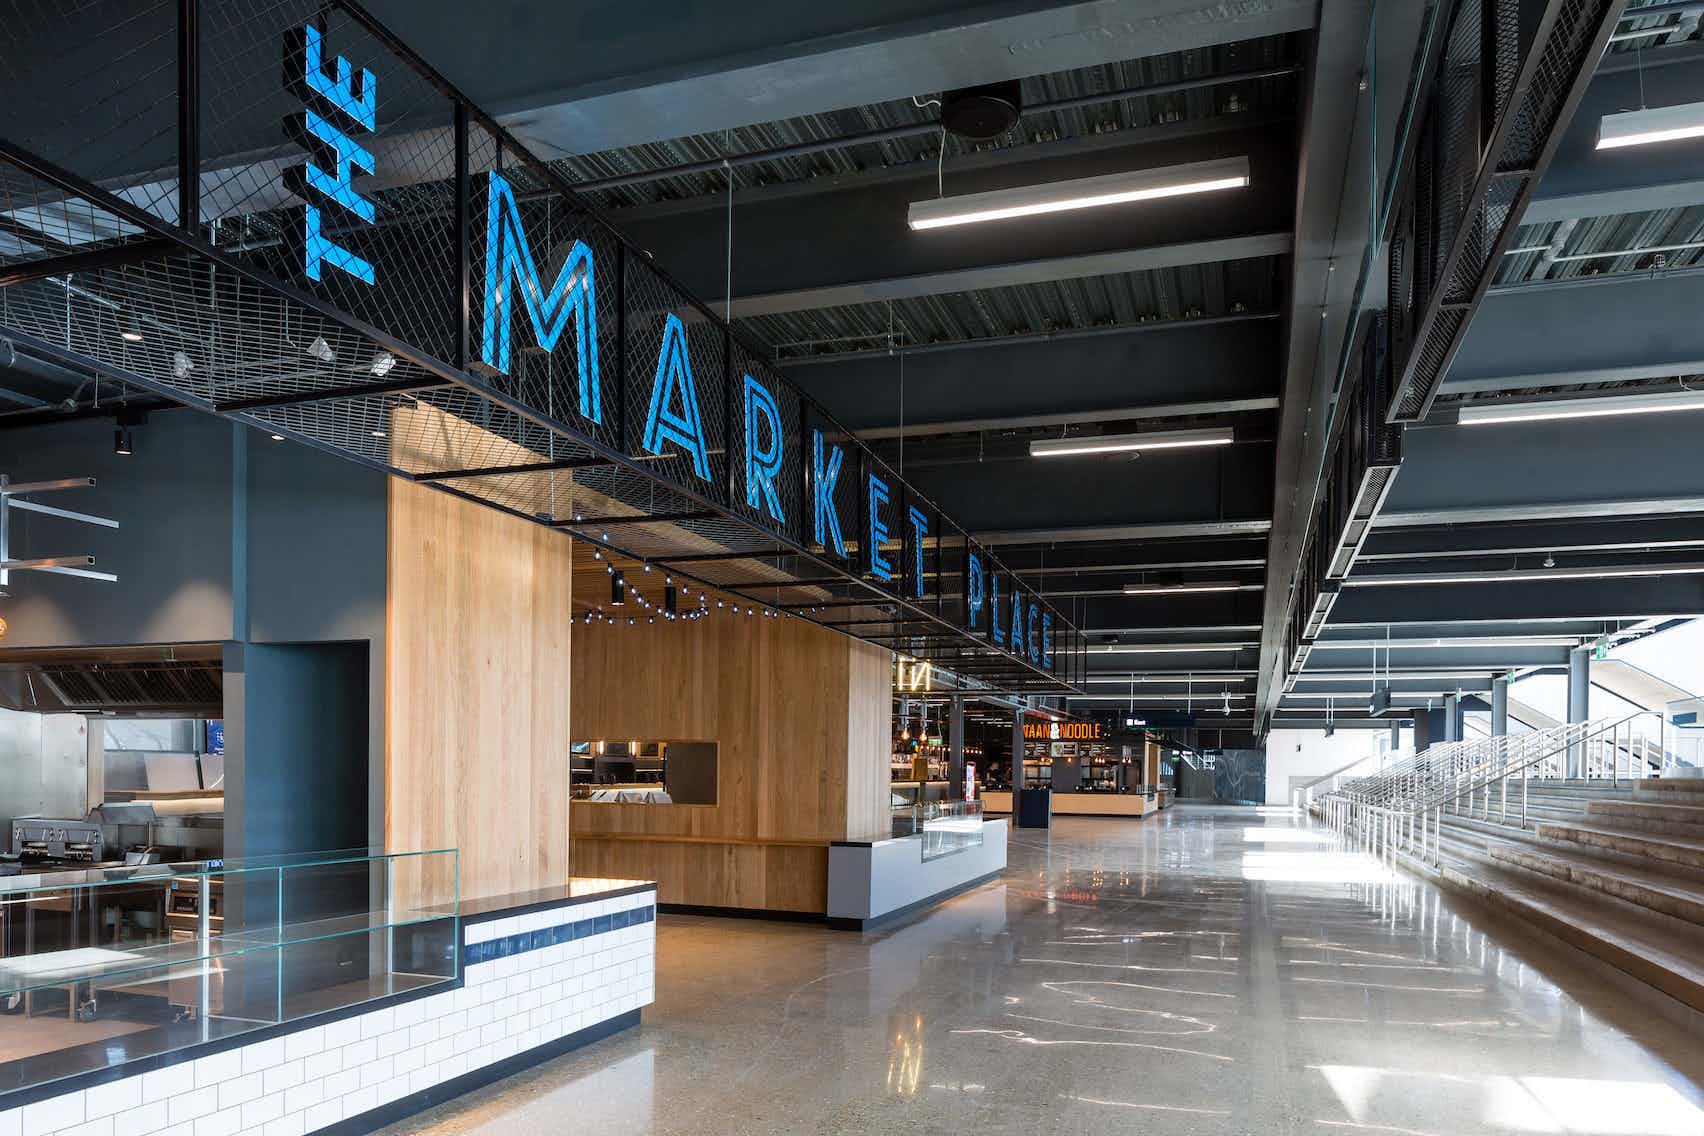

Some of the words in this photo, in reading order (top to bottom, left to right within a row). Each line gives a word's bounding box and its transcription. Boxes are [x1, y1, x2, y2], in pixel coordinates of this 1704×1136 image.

[304, 24, 376, 286] THE
[482, 169, 927, 598] MARKET
[969, 553, 1051, 669] PLACE
